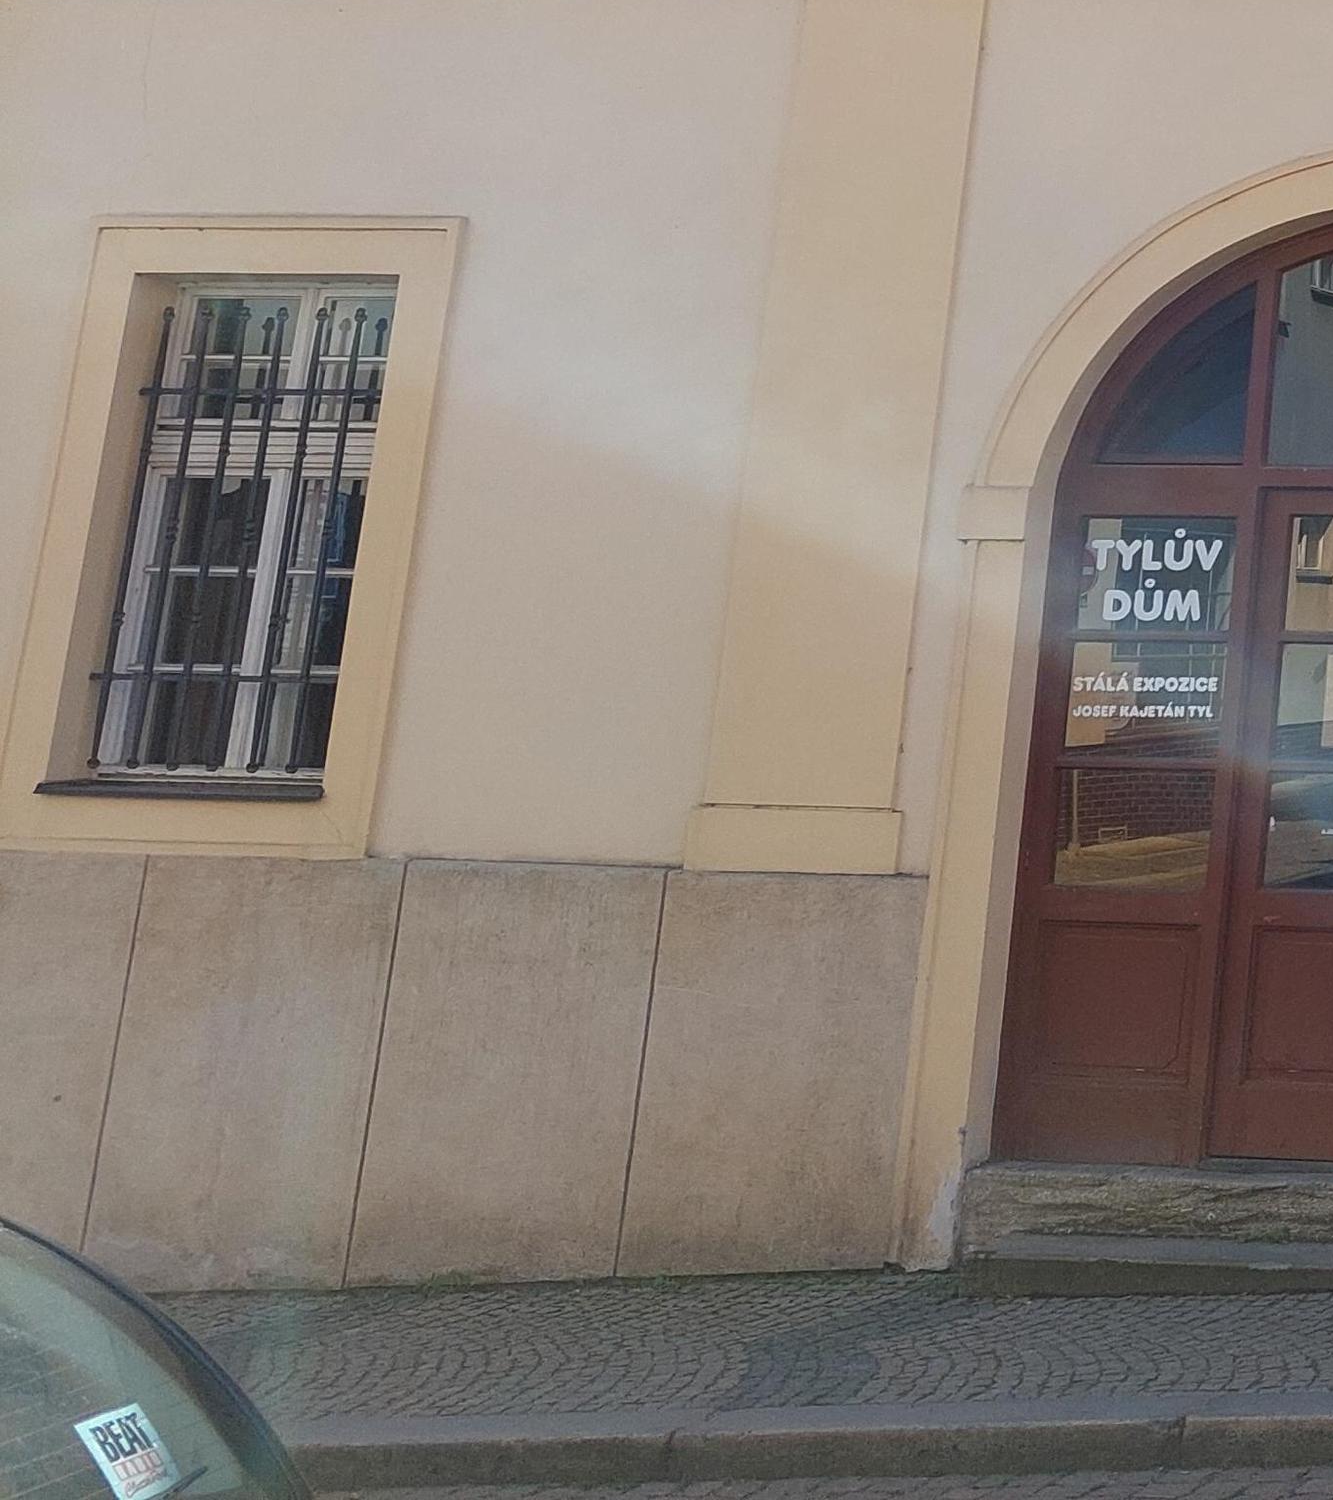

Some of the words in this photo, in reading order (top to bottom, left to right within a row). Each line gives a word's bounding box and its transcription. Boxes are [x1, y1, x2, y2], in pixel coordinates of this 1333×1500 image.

[1091, 527, 1223, 571] TYLŮV
[1102, 578, 1201, 621] DŮM
[1072, 672, 1130, 692] STÁLÁ
[1132, 676, 1219, 692] EXPOZICE
[1072, 705, 1117, 718] JOSEF
[1119, 701, 1185, 718] KAJETÁN
[1188, 705, 1214, 718] TYL
[88, 1412, 154, 1463] BEAT
